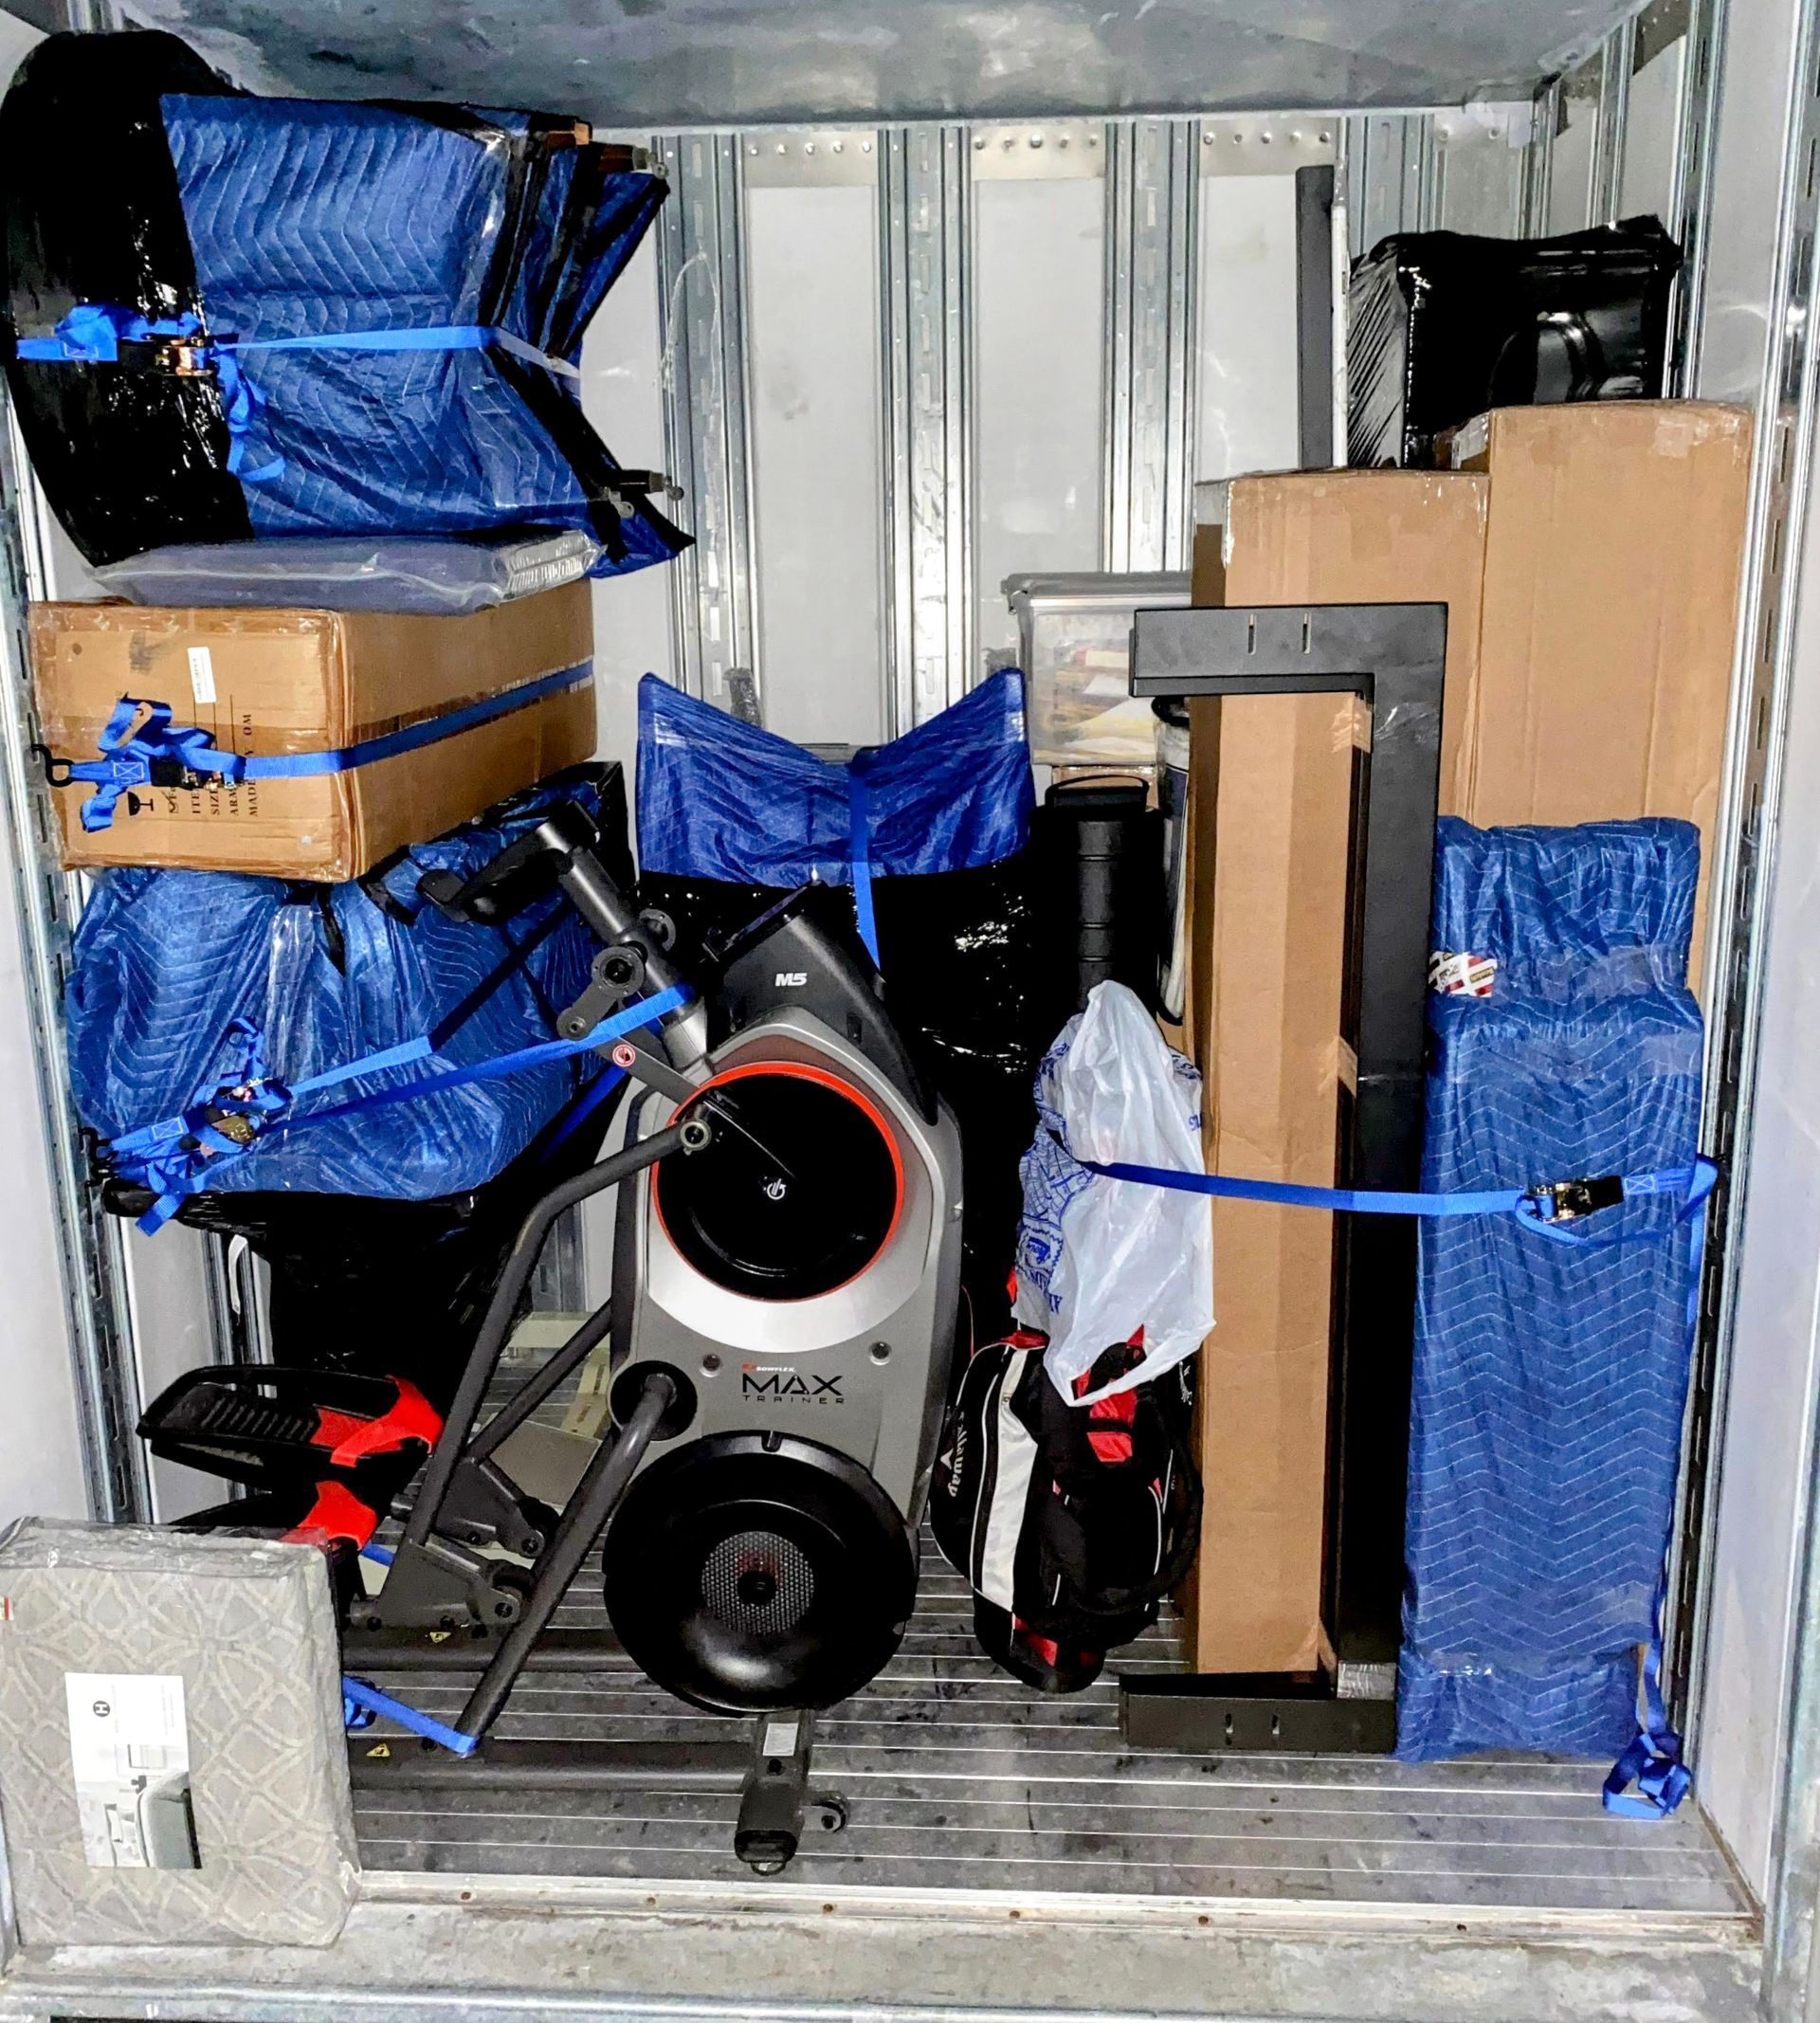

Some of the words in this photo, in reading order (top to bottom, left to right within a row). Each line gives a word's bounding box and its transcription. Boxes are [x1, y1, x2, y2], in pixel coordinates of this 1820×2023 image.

[242, 714, 253, 737] OM
[191, 787, 202, 814] ITE
[247, 778, 259, 818] MADE
[775, 972, 808, 987] M5
[742, 1373, 843, 1396] MAX
[742, 1394, 845, 1405] TRAINER
